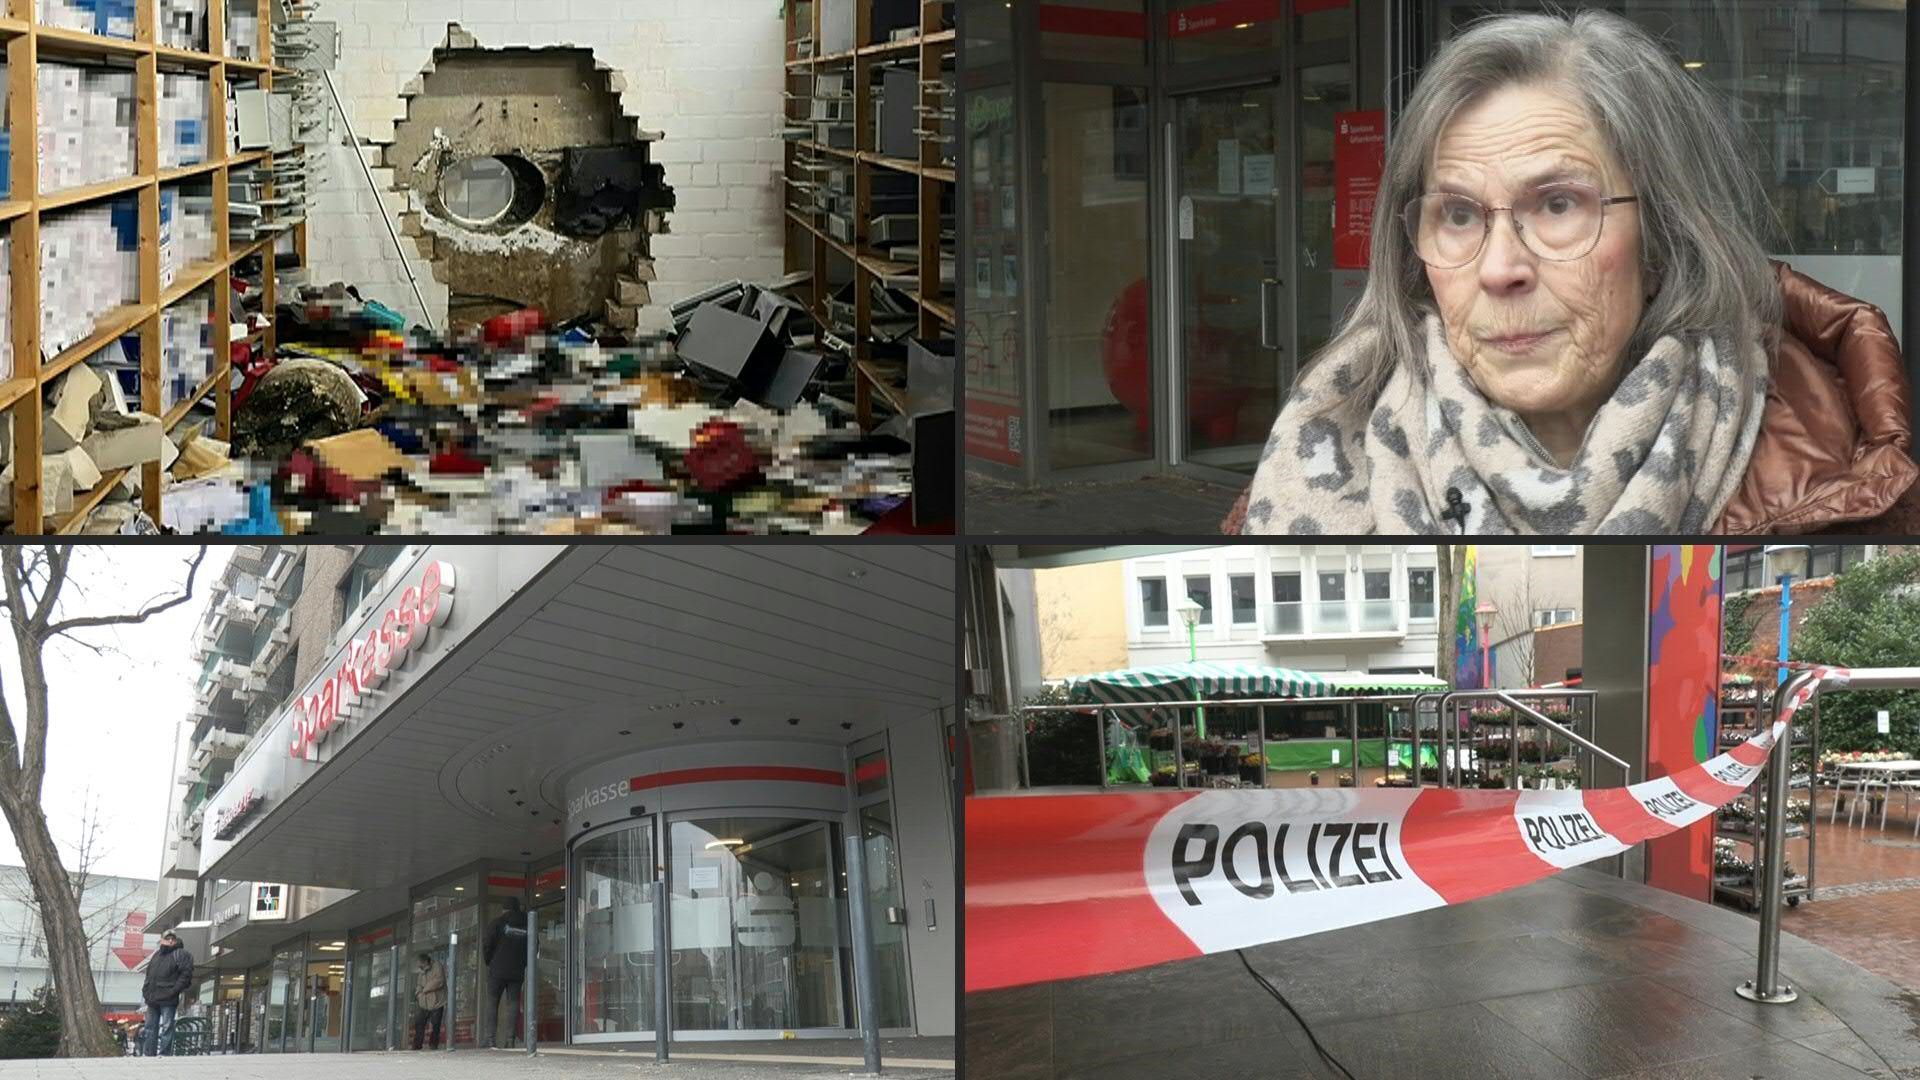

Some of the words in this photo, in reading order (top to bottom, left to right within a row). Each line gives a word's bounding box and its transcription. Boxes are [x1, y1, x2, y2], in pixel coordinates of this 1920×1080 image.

[290, 559, 455, 762] Sparkasse
[1523, 812, 1606, 854] POLIZEI
[1644, 790, 1697, 819] POLIZEI
[1172, 821, 1402, 906] POLIZEI
